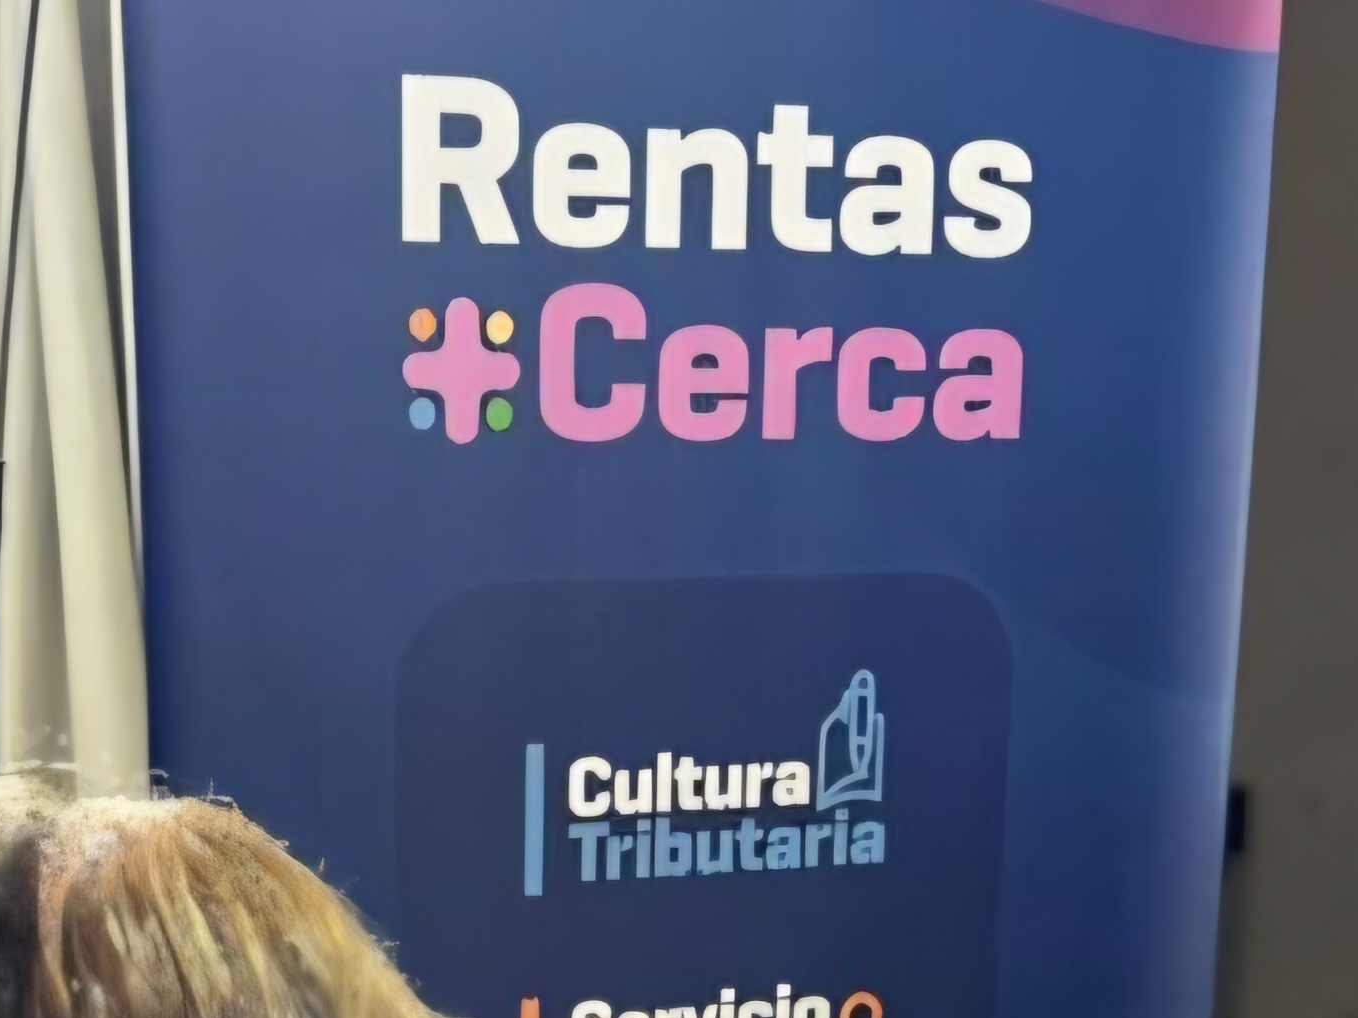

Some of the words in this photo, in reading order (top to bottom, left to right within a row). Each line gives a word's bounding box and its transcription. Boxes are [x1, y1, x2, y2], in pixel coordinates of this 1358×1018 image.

[401, 74, 1033, 258] Rentas
[568, 752, 810, 817] Cultura
[568, 809, 885, 881] Tributaria
